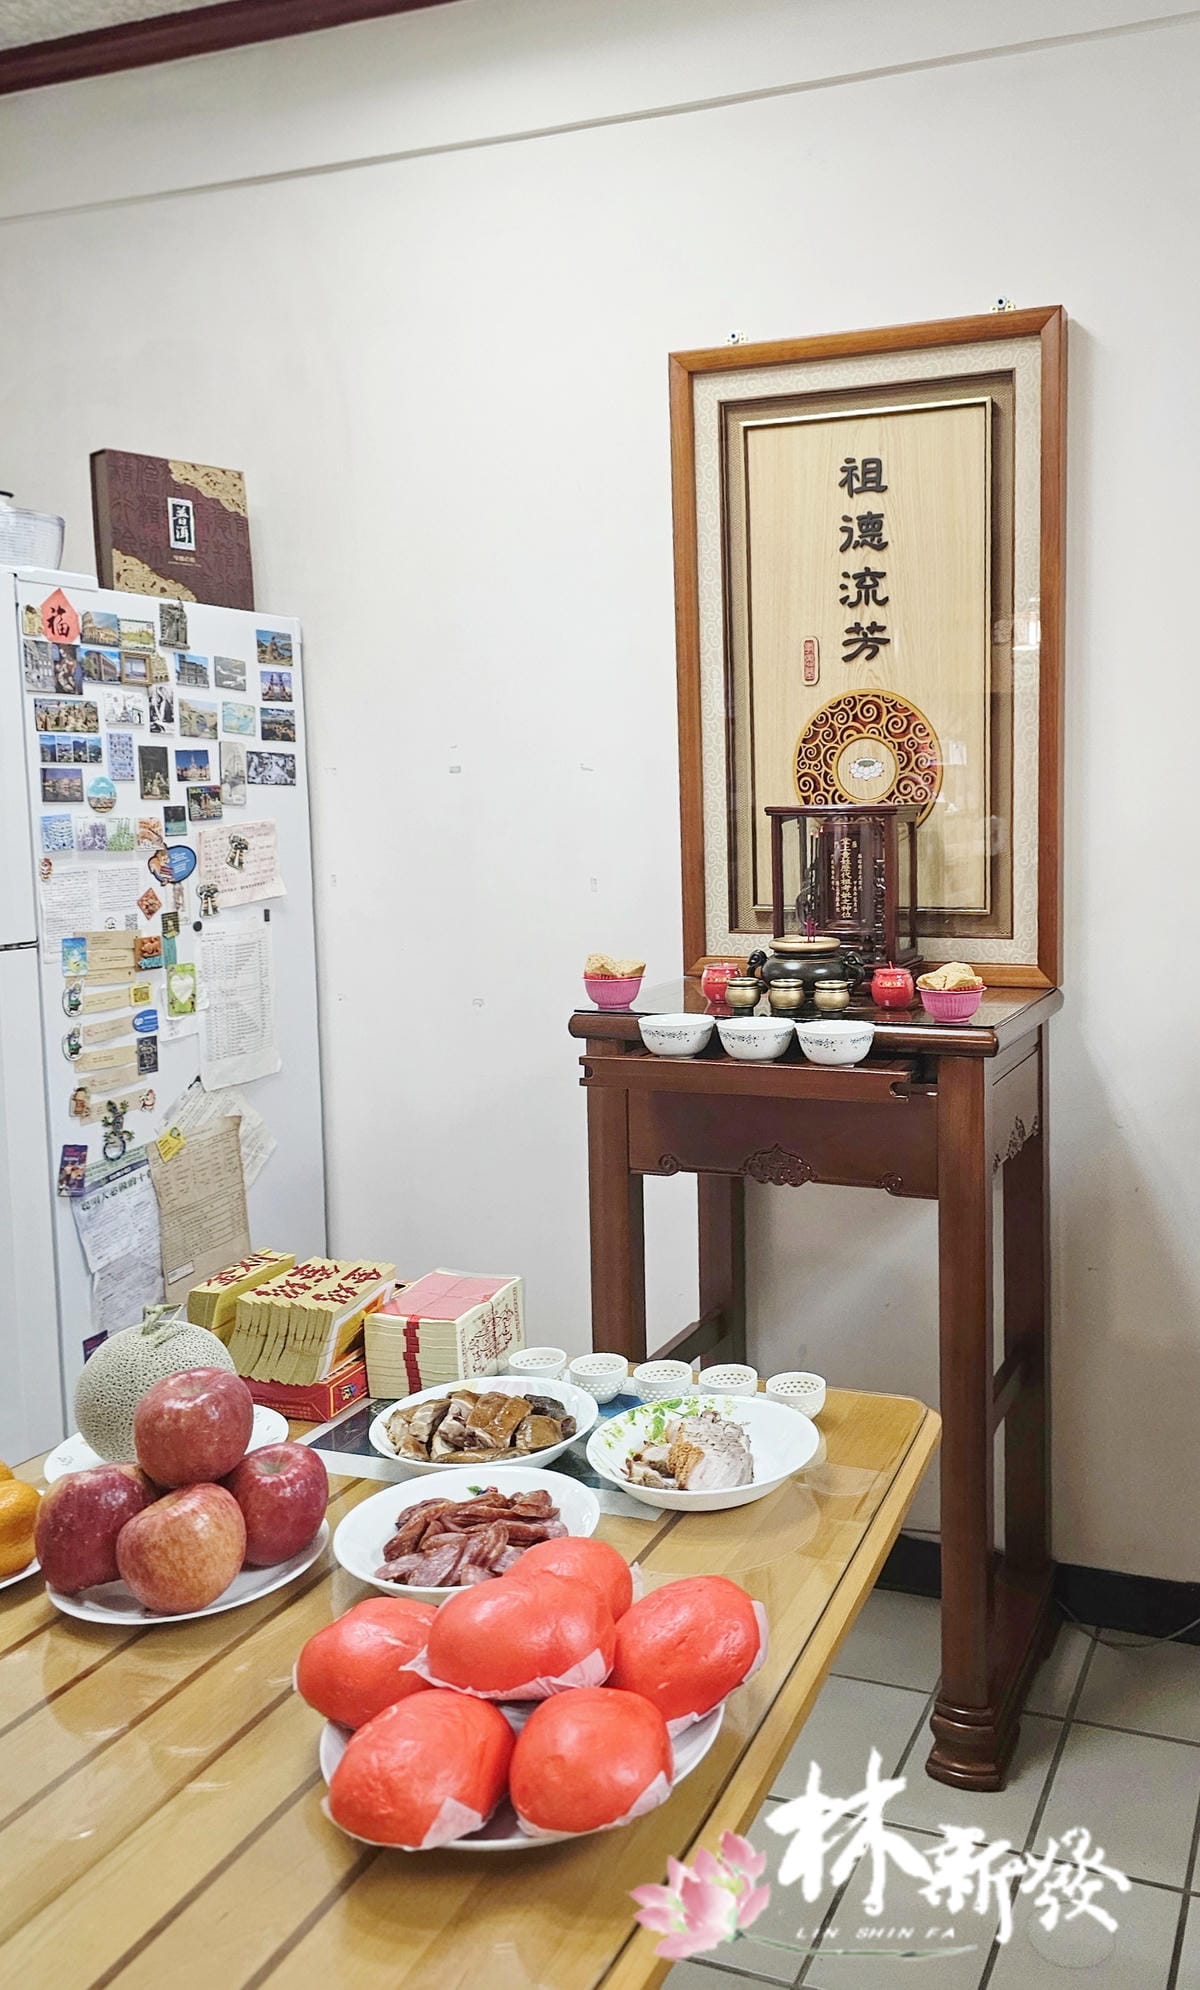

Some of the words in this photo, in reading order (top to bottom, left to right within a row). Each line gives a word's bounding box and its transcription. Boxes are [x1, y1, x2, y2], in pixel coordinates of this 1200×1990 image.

[838, 456, 891, 663] 祖德流芳
[46, 605, 71, 638] 福
